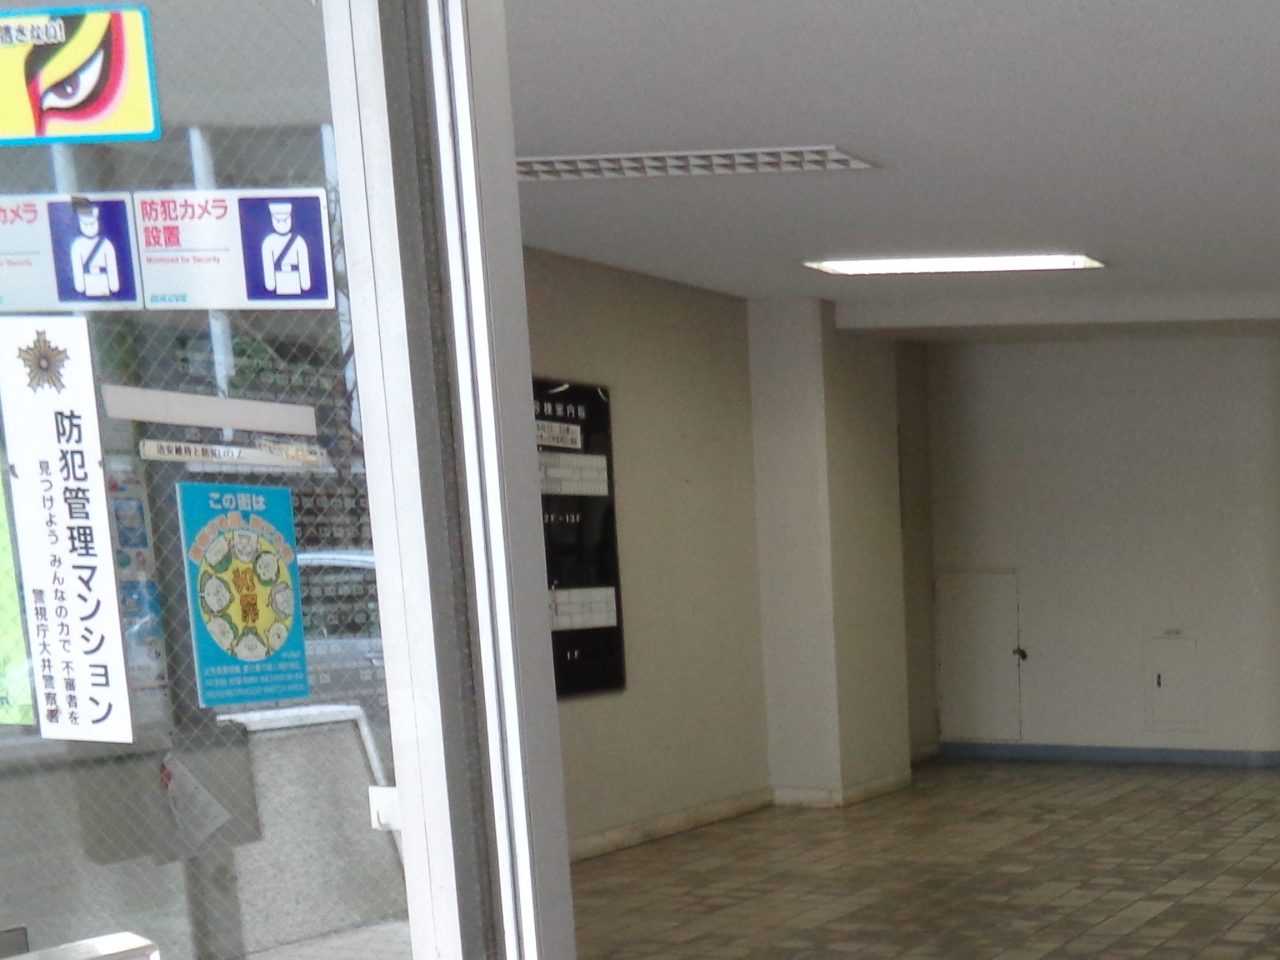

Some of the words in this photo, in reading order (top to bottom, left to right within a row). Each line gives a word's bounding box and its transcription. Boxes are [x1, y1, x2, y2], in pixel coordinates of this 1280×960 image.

[140, 198, 228, 221] 防犯カメラ
[143, 225, 181, 248] 設置
[38, 459, 60, 546] 見つけよう
[50, 553, 72, 655] みんなの力で
[61, 659, 80, 726] 不審者を
[54, 409, 113, 725] 防犯管理マンション
[32, 587, 60, 724] 警視庁大井警察署
